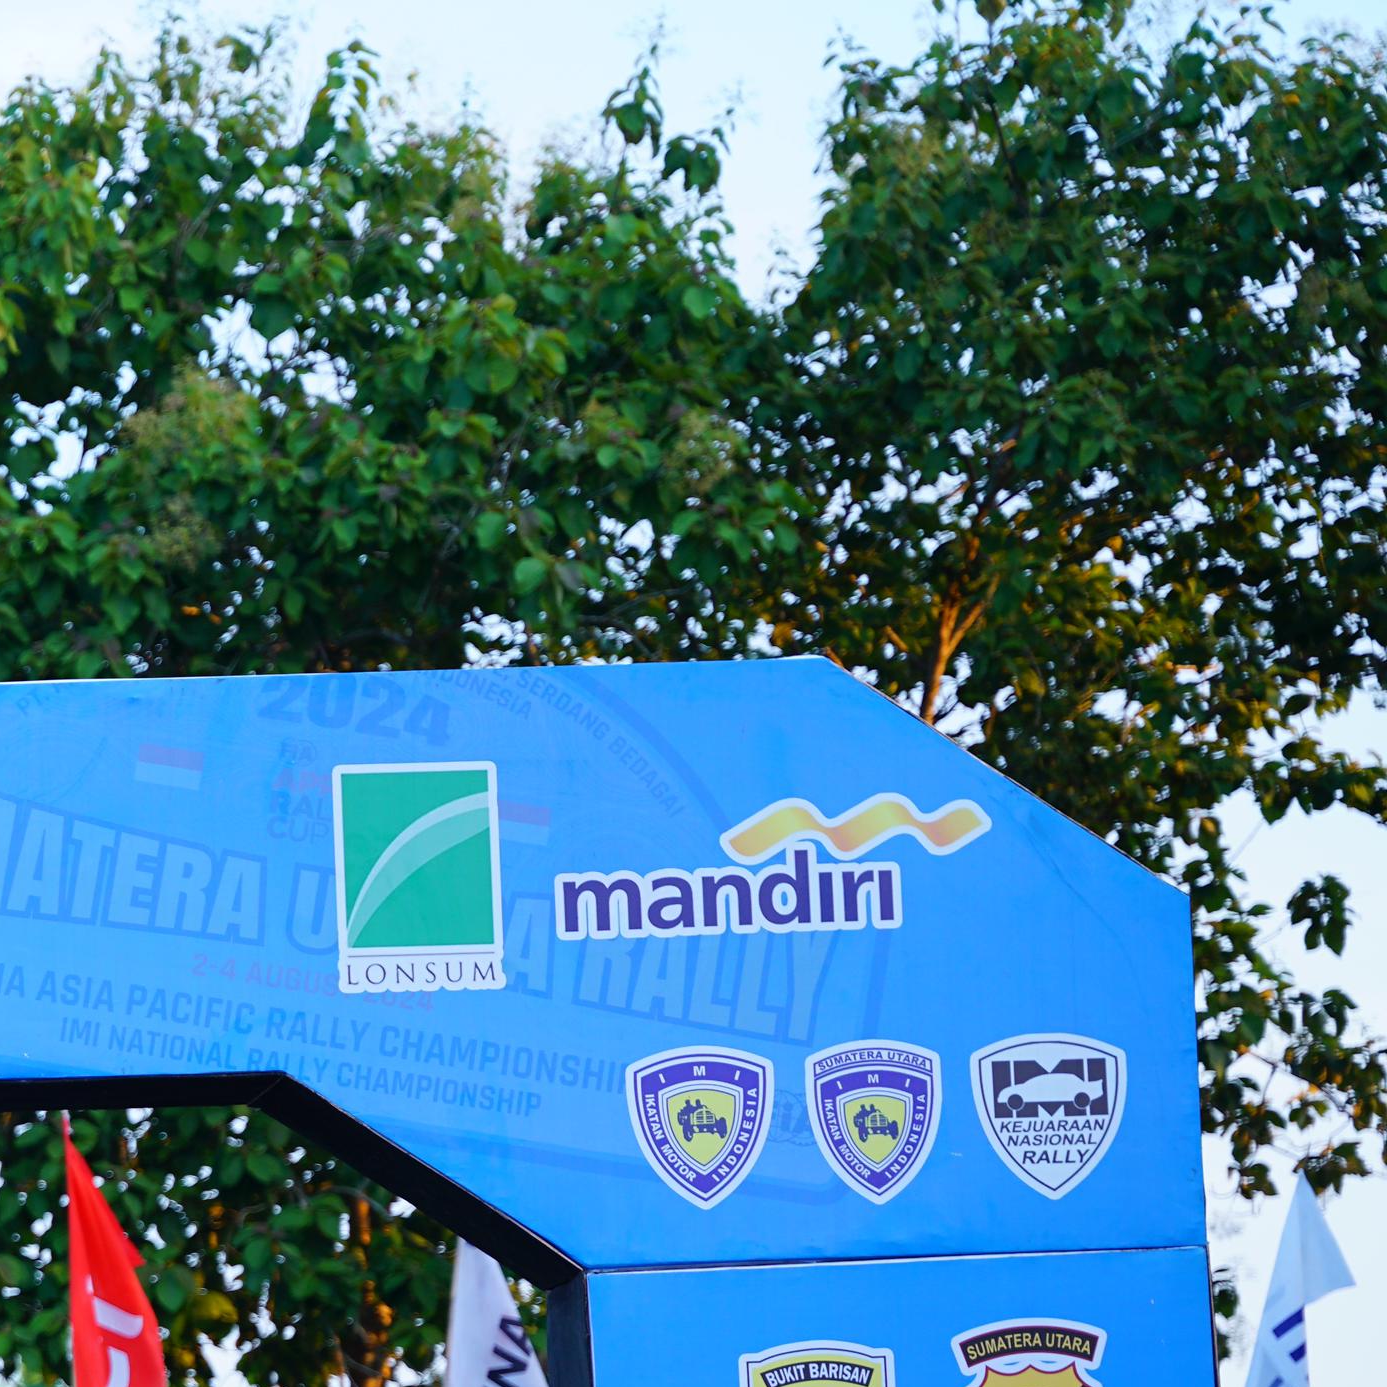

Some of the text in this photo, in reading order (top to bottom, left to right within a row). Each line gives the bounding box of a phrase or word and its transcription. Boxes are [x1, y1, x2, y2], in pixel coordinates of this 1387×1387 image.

[604, 736, 687, 820] BEDAGAI
[562, 849, 895, 933] mandiri
[346, 961, 498, 987] LONSUM
[36, 970, 116, 1014] ASIA
[127, 981, 256, 1036] PACIFIC
[265, 1006, 372, 1053] RALLY
[59, 1016, 100, 1047] IMI
[107, 1025, 238, 1071] NATIONAL
[336, 1058, 543, 1119] CHAMPIONSHIP
[818, 1050, 928, 1071] SUMATERA UTARA
[645, 1087, 758, 1183] IKATAN MOTOR INDONESIA
[824, 1093, 927, 1180] IKATAN MOTOR INDONESIA
[999, 1118, 1106, 1134] KEJUARAAN
[1006, 1133, 1098, 1148] NASIONAL
[1022, 1148, 1090, 1165] RALLY
[966, 1332, 1092, 1361] SUMATERA UTARA
[766, 1362, 871, 1387] BUKIT BARISAN
